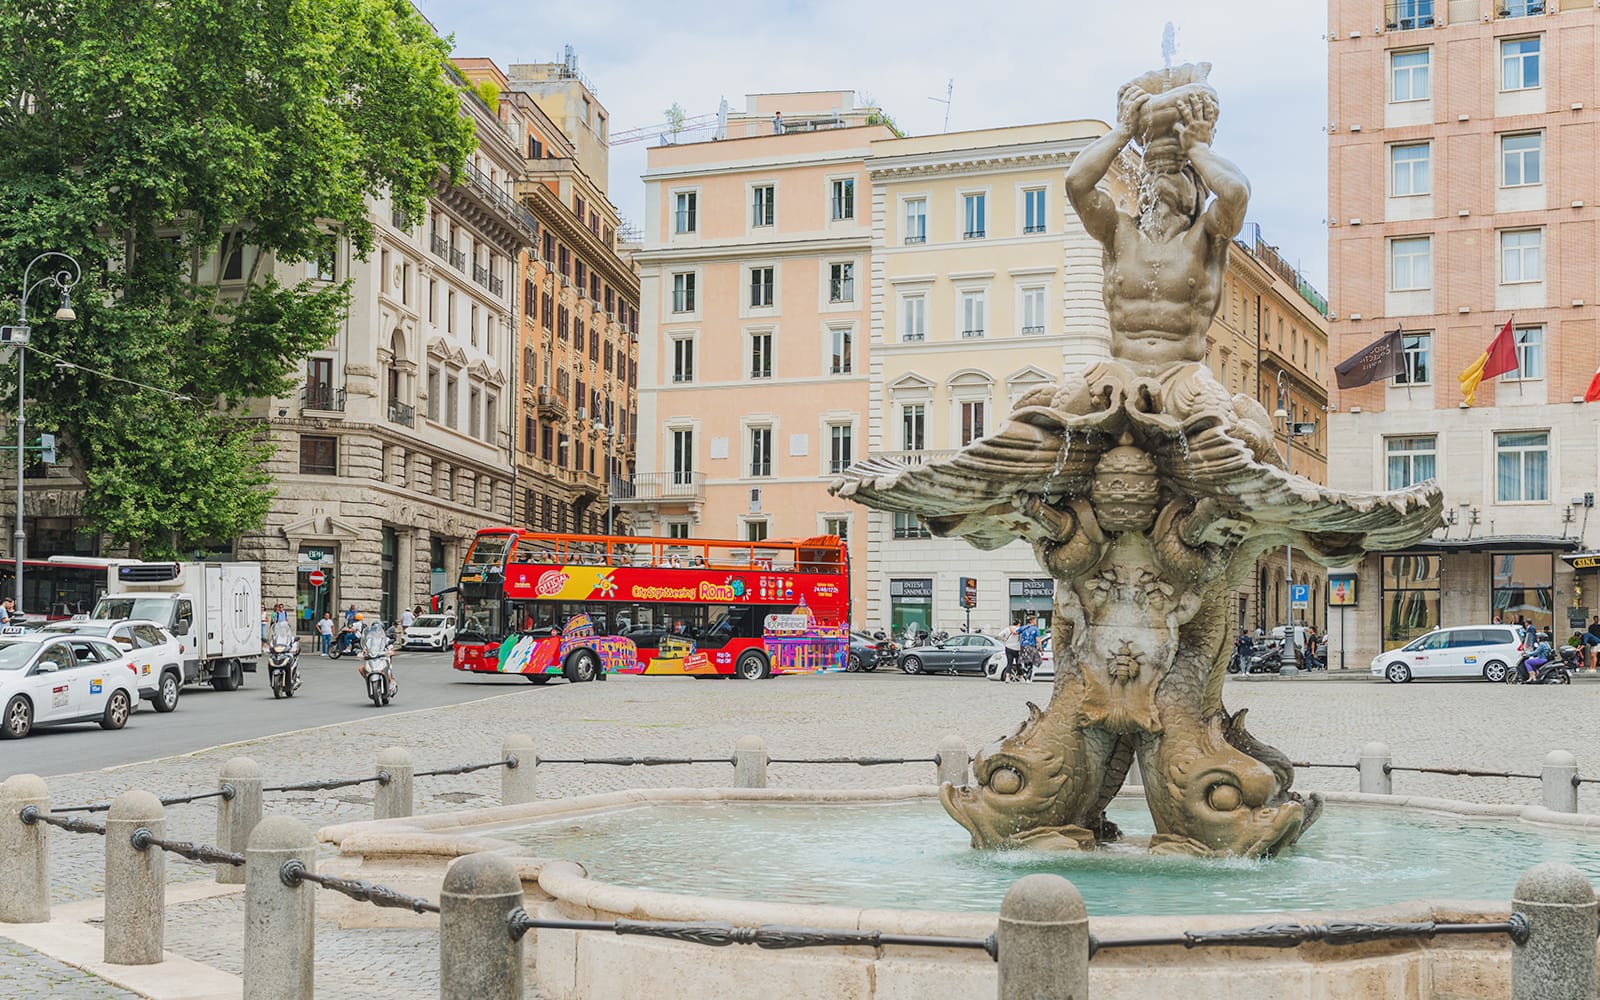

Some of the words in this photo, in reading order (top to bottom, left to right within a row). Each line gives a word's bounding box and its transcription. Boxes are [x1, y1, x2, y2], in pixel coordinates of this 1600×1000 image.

[1578, 558, 1596, 566] SINA
[539, 573, 569, 592] OFFICIAL
[1295, 587, 1305, 599] P
